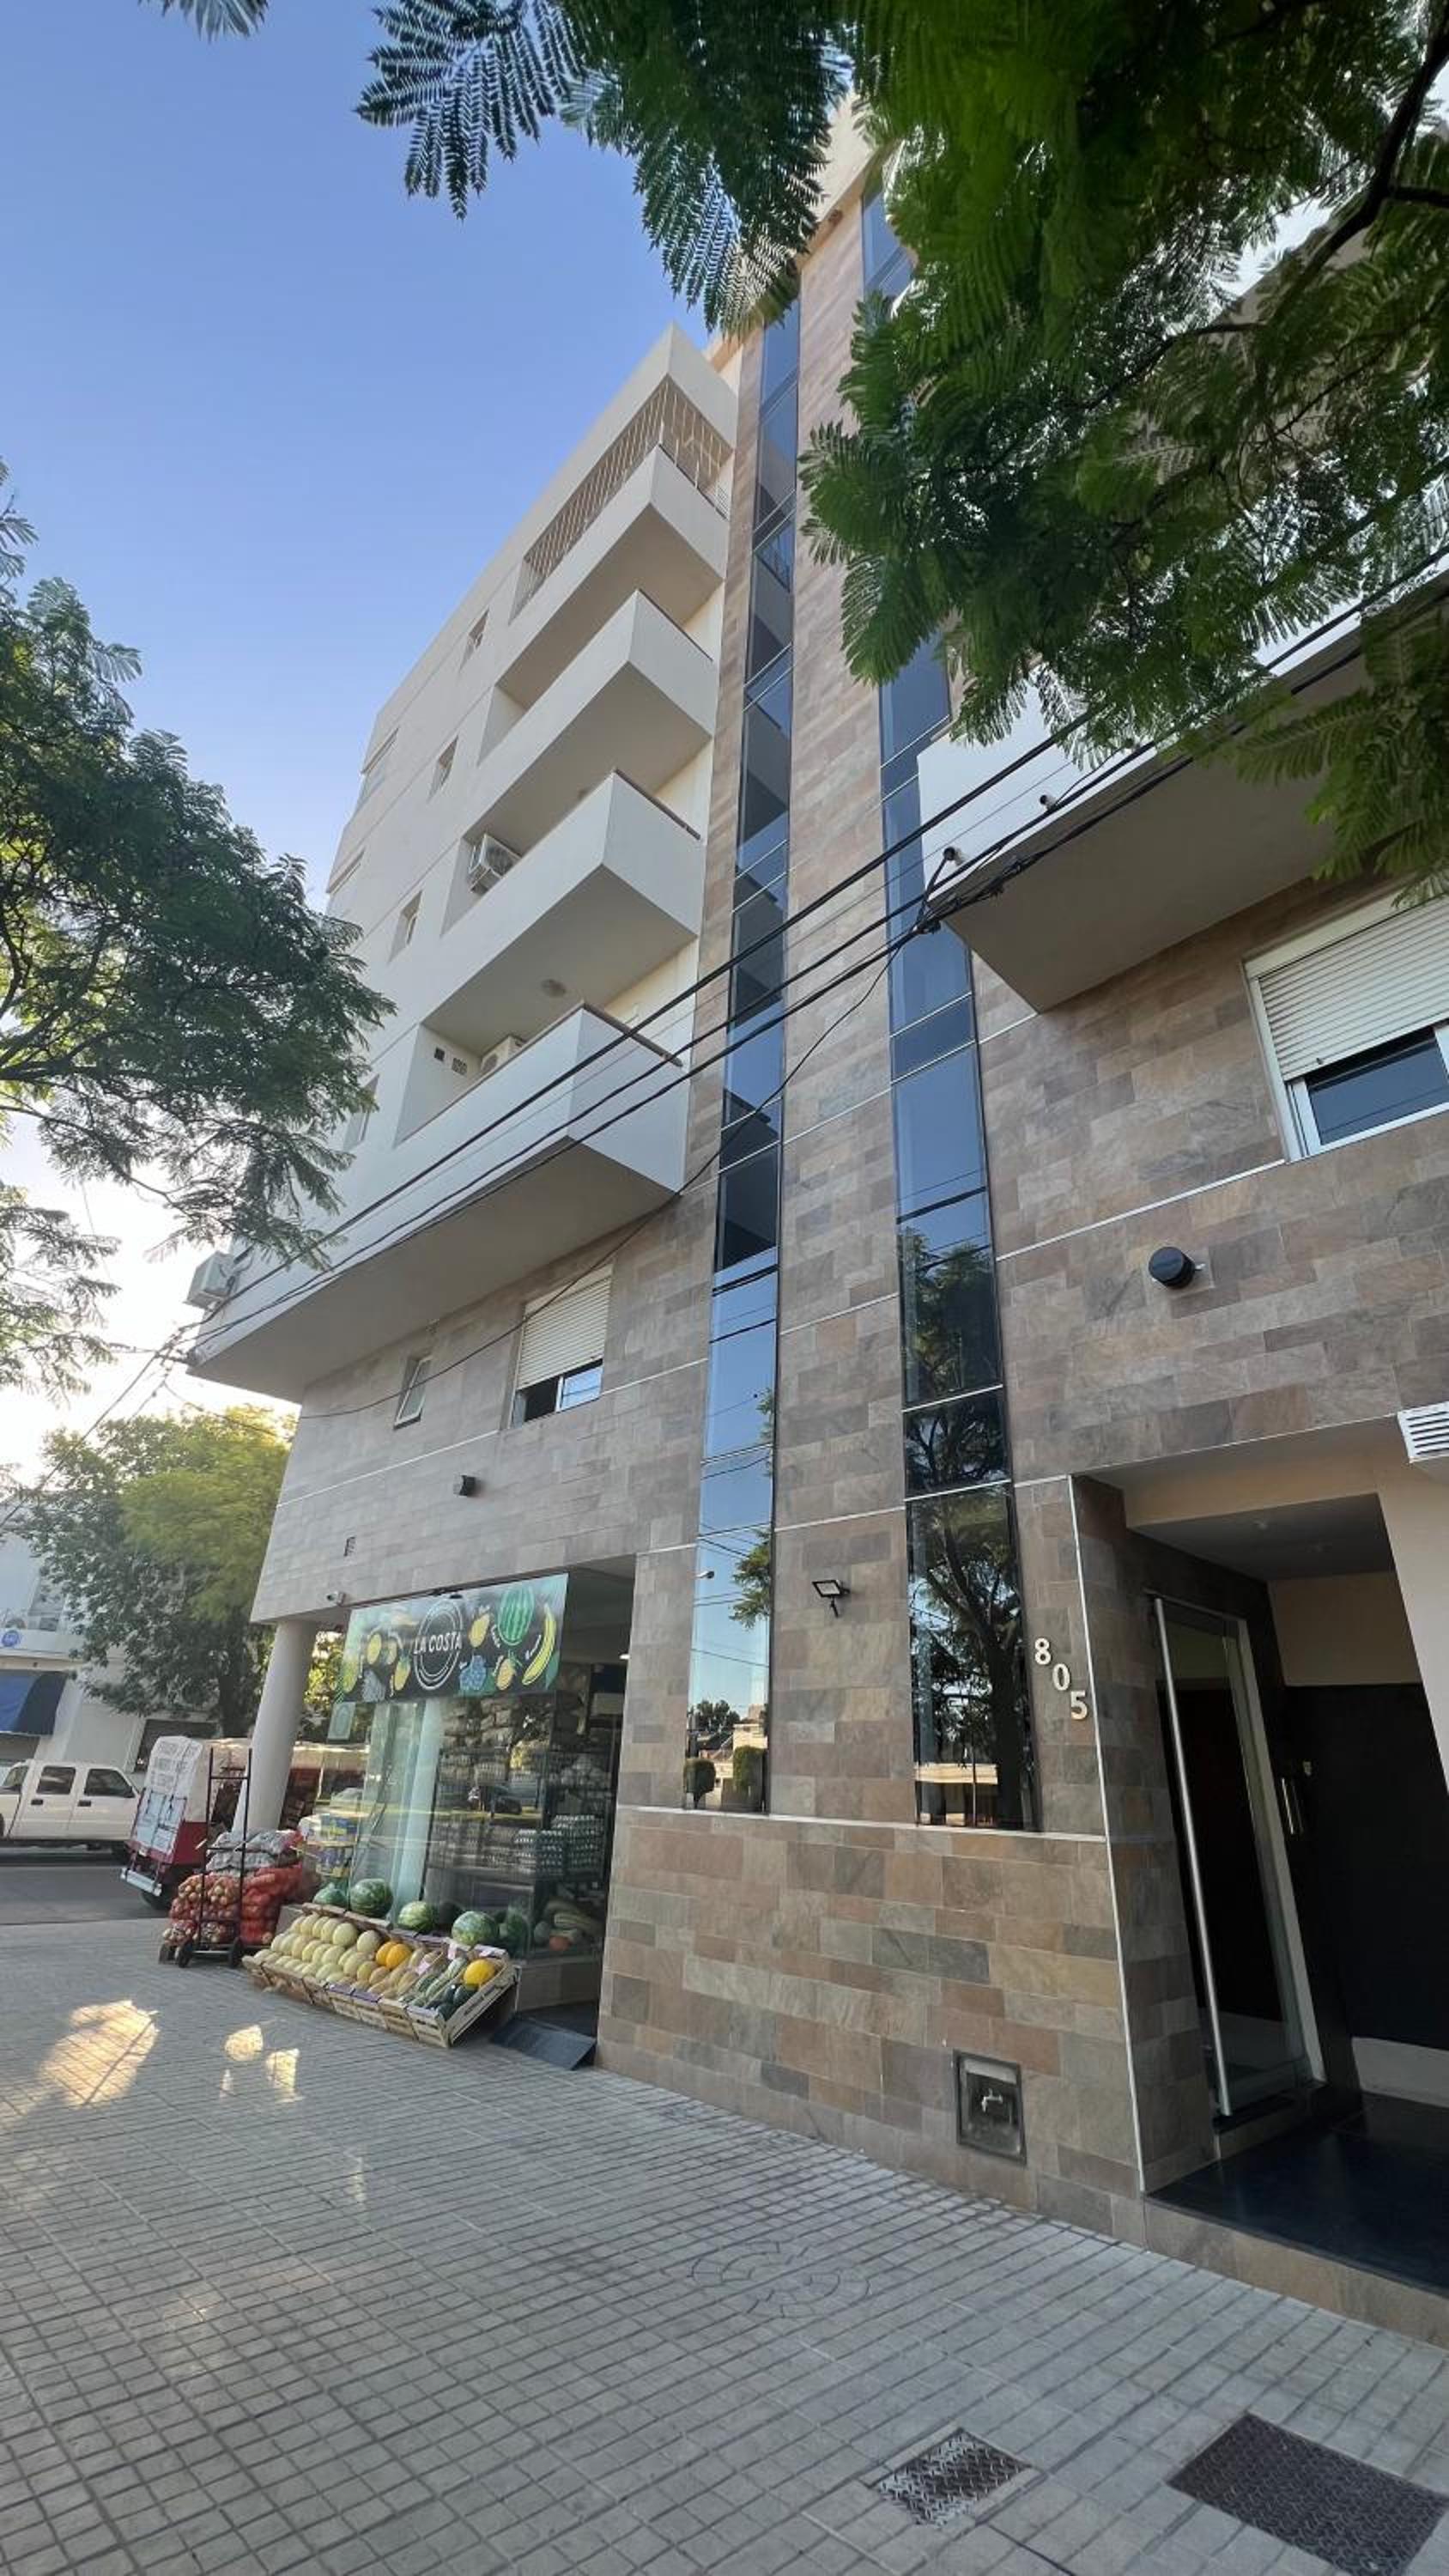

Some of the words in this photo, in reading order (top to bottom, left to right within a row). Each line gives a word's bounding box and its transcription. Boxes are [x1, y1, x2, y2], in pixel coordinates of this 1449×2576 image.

[413, 1636, 427, 1655] LA
[428, 1631, 463, 1653] COSTA
[1034, 1637, 1088, 1720] 805
